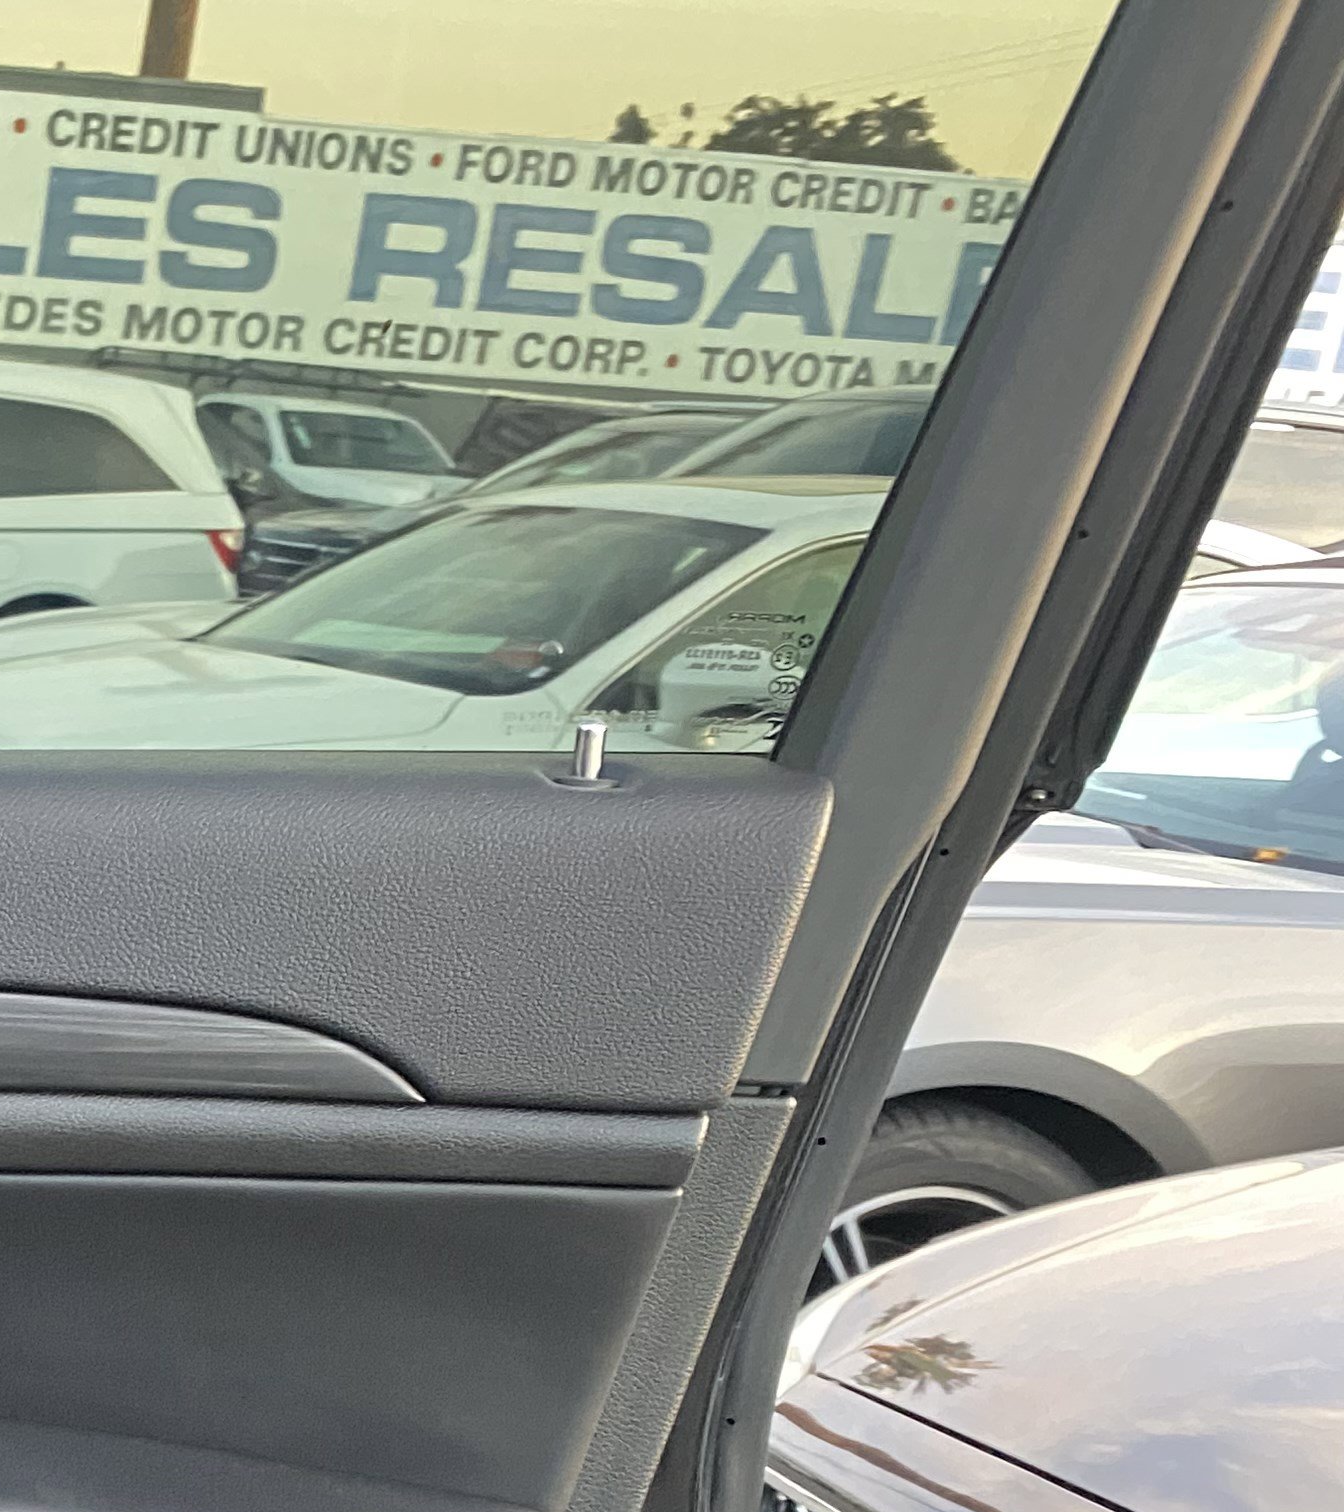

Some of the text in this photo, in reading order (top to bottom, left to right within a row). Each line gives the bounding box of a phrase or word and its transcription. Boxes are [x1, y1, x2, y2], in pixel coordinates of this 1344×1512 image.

[46, 108, 220, 160] CREDIT
[234, 125, 416, 177] UNIONS
[454, 143, 577, 189] FORD
[591, 156, 756, 205] MOTOR
[769, 170, 933, 220] CREDIT
[121, 305, 305, 353] MOTOR
[323, 317, 501, 367] CREDIT
[513, 332, 649, 377] CORP.
[699, 344, 877, 388] TOYOTA
